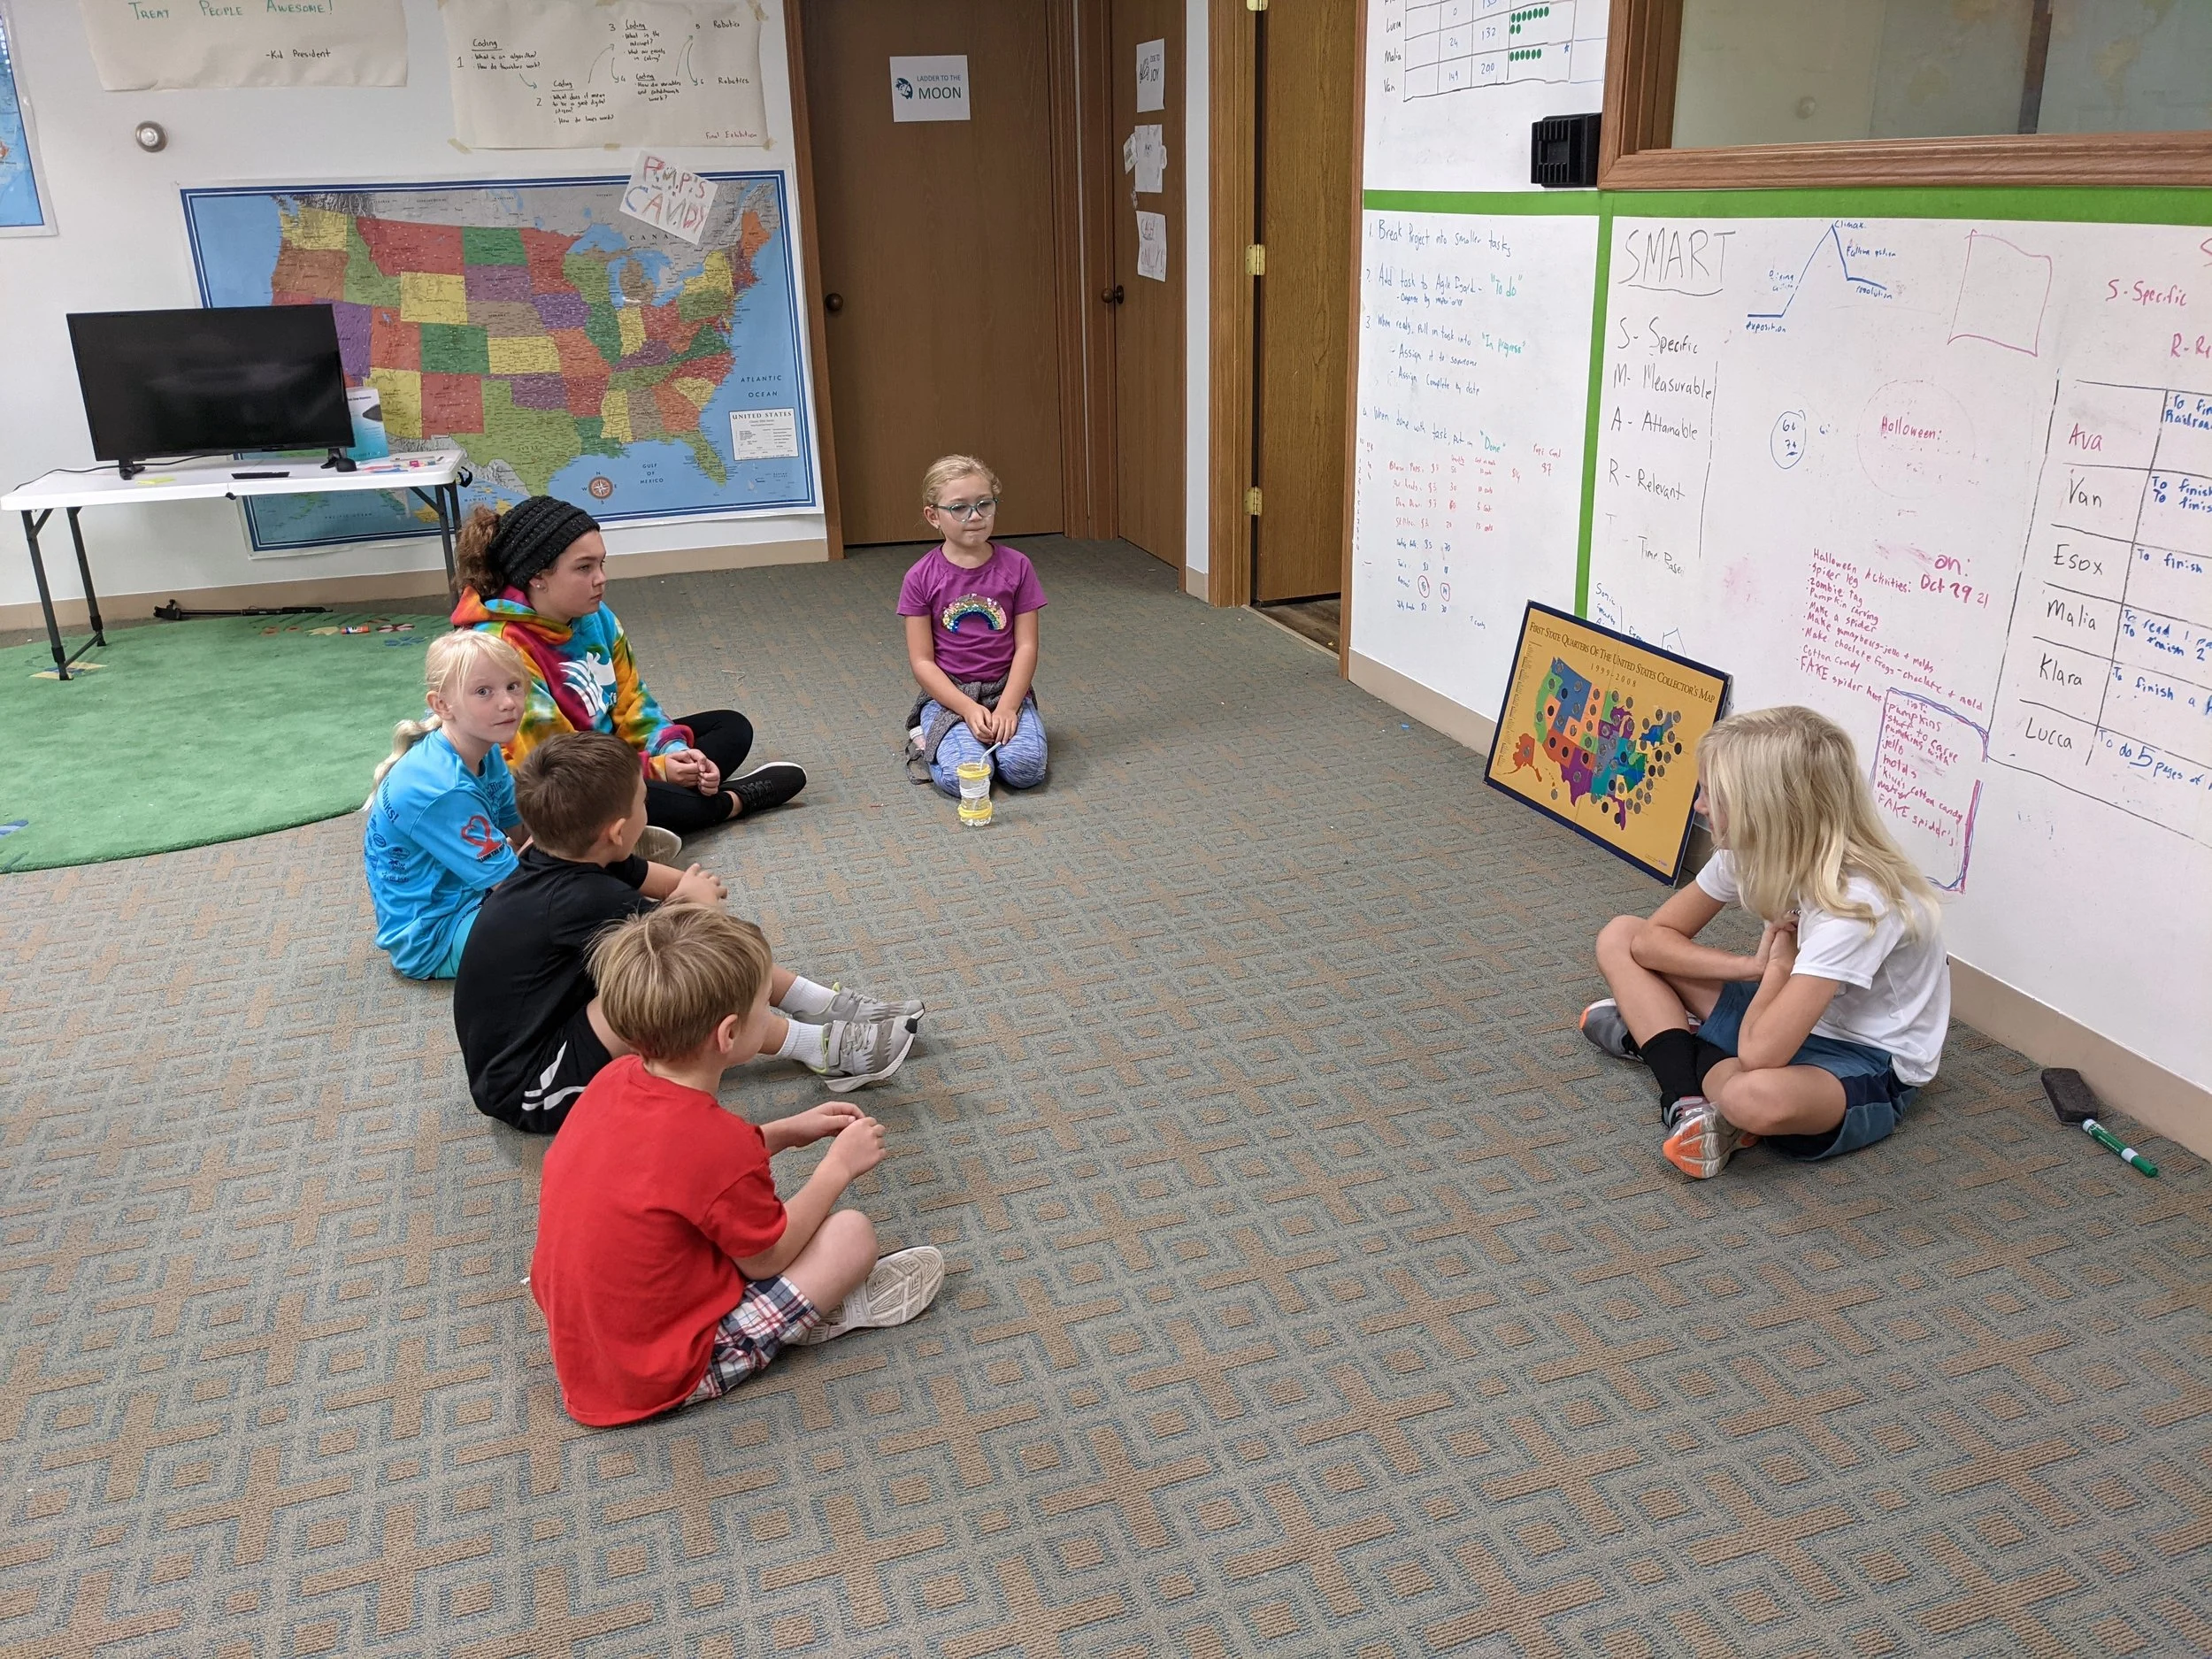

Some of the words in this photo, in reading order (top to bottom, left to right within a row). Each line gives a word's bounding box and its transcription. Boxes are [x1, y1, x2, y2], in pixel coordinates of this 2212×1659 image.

[128, 2, 170, 20] TREAT
[199, 0, 243, 17] PEOPLE
[266, 0, 334, 15] AWESOME!
[626, 19, 647, 30] Coding
[1481, 27, 1496, 40] 132
[292, 48, 331, 58] President
[472, 39, 498, 49] Coding
[1384, 48, 1402, 64] Malia
[1480, 63, 1495, 74] 200
[553, 80, 572, 88] Coding
[918, 87, 961, 99] MOON
[1383, 78, 1395, 92] Van
[536, 98, 542, 107] 2
[1379, 219, 1402, 242] Break
[1409, 223, 1430, 251] Project
[1488, 230, 1511, 257] tasks
[1617, 227, 1736, 284] SMART
[1379, 263, 1393, 288] Add
[1401, 268, 1416, 288] task
[1421, 274, 1428, 289] to
[1436, 273, 1451, 295] Agile
[1378, 314, 1391, 328] When
[1440, 325, 1455, 341] task
[1458, 332, 1471, 346] into
[1649, 316, 1698, 354] Specific
[1746, 320, 1786, 334] exposition
[1399, 343, 1421, 361] Assign
[1439, 350, 1445, 362] to
[1398, 366, 1417, 383] Assign
[1643, 363, 1712, 400] Measurable
[2174, 394, 2185, 410] To
[1641, 410, 1698, 441] Attainable
[2069, 422, 2103, 452] Ava
[1637, 468, 1686, 501] Relevant
[2069, 477, 2103, 508] Van
[2152, 475, 2168, 489] To
[2153, 489, 2167, 503] To
[1813, 548, 1856, 574] Halloween
[2054, 543, 2103, 576] Esox
[2137, 549, 2150, 561] To
[2164, 553, 2203, 574] finish
[1847, 573, 1859, 588] leg
[1807, 612, 1832, 632] Make
[1847, 616, 1877, 634] spider
[2047, 599, 2096, 630] Malia
[2143, 618, 2171, 637] read
[1804, 626, 1827, 642] Make
[2124, 624, 2135, 637] To
[2196, 648, 2206, 662] 2
[1529, 622, 1546, 635] FIRST
[1545, 627, 1562, 641] STATE
[1561, 634, 1589, 653] QUARTERS
[1589, 644, 1600, 656] OF
[1600, 649, 1613, 663] THE
[1613, 656, 1636, 672] UNITED
[1636, 664, 1657, 679] STATES
[1656, 672, 1699, 696] COLLECTOR'S
[1699, 689, 1716, 704] MAP
[1591, 664, 1637, 687] 1999-2008
[1801, 657, 1829, 680] FAKE
[1832, 676, 1863, 694] spider
[2039, 653, 2082, 687] Klara
[2113, 666, 2123, 680] To
[2135, 676, 2174, 700] finish
[2188, 697, 2195, 707] a
[1916, 728, 1928, 741] to
[1931, 740, 1958, 763] carve
[1928, 748, 1949, 766] with
[2025, 717, 2072, 749] Lucca
[2099, 729, 2113, 748] To
[2119, 742, 2131, 757] do
[2129, 745, 2155, 767] 5
[2154, 762, 2183, 780] pages
[1939, 803, 1962, 825] candy
